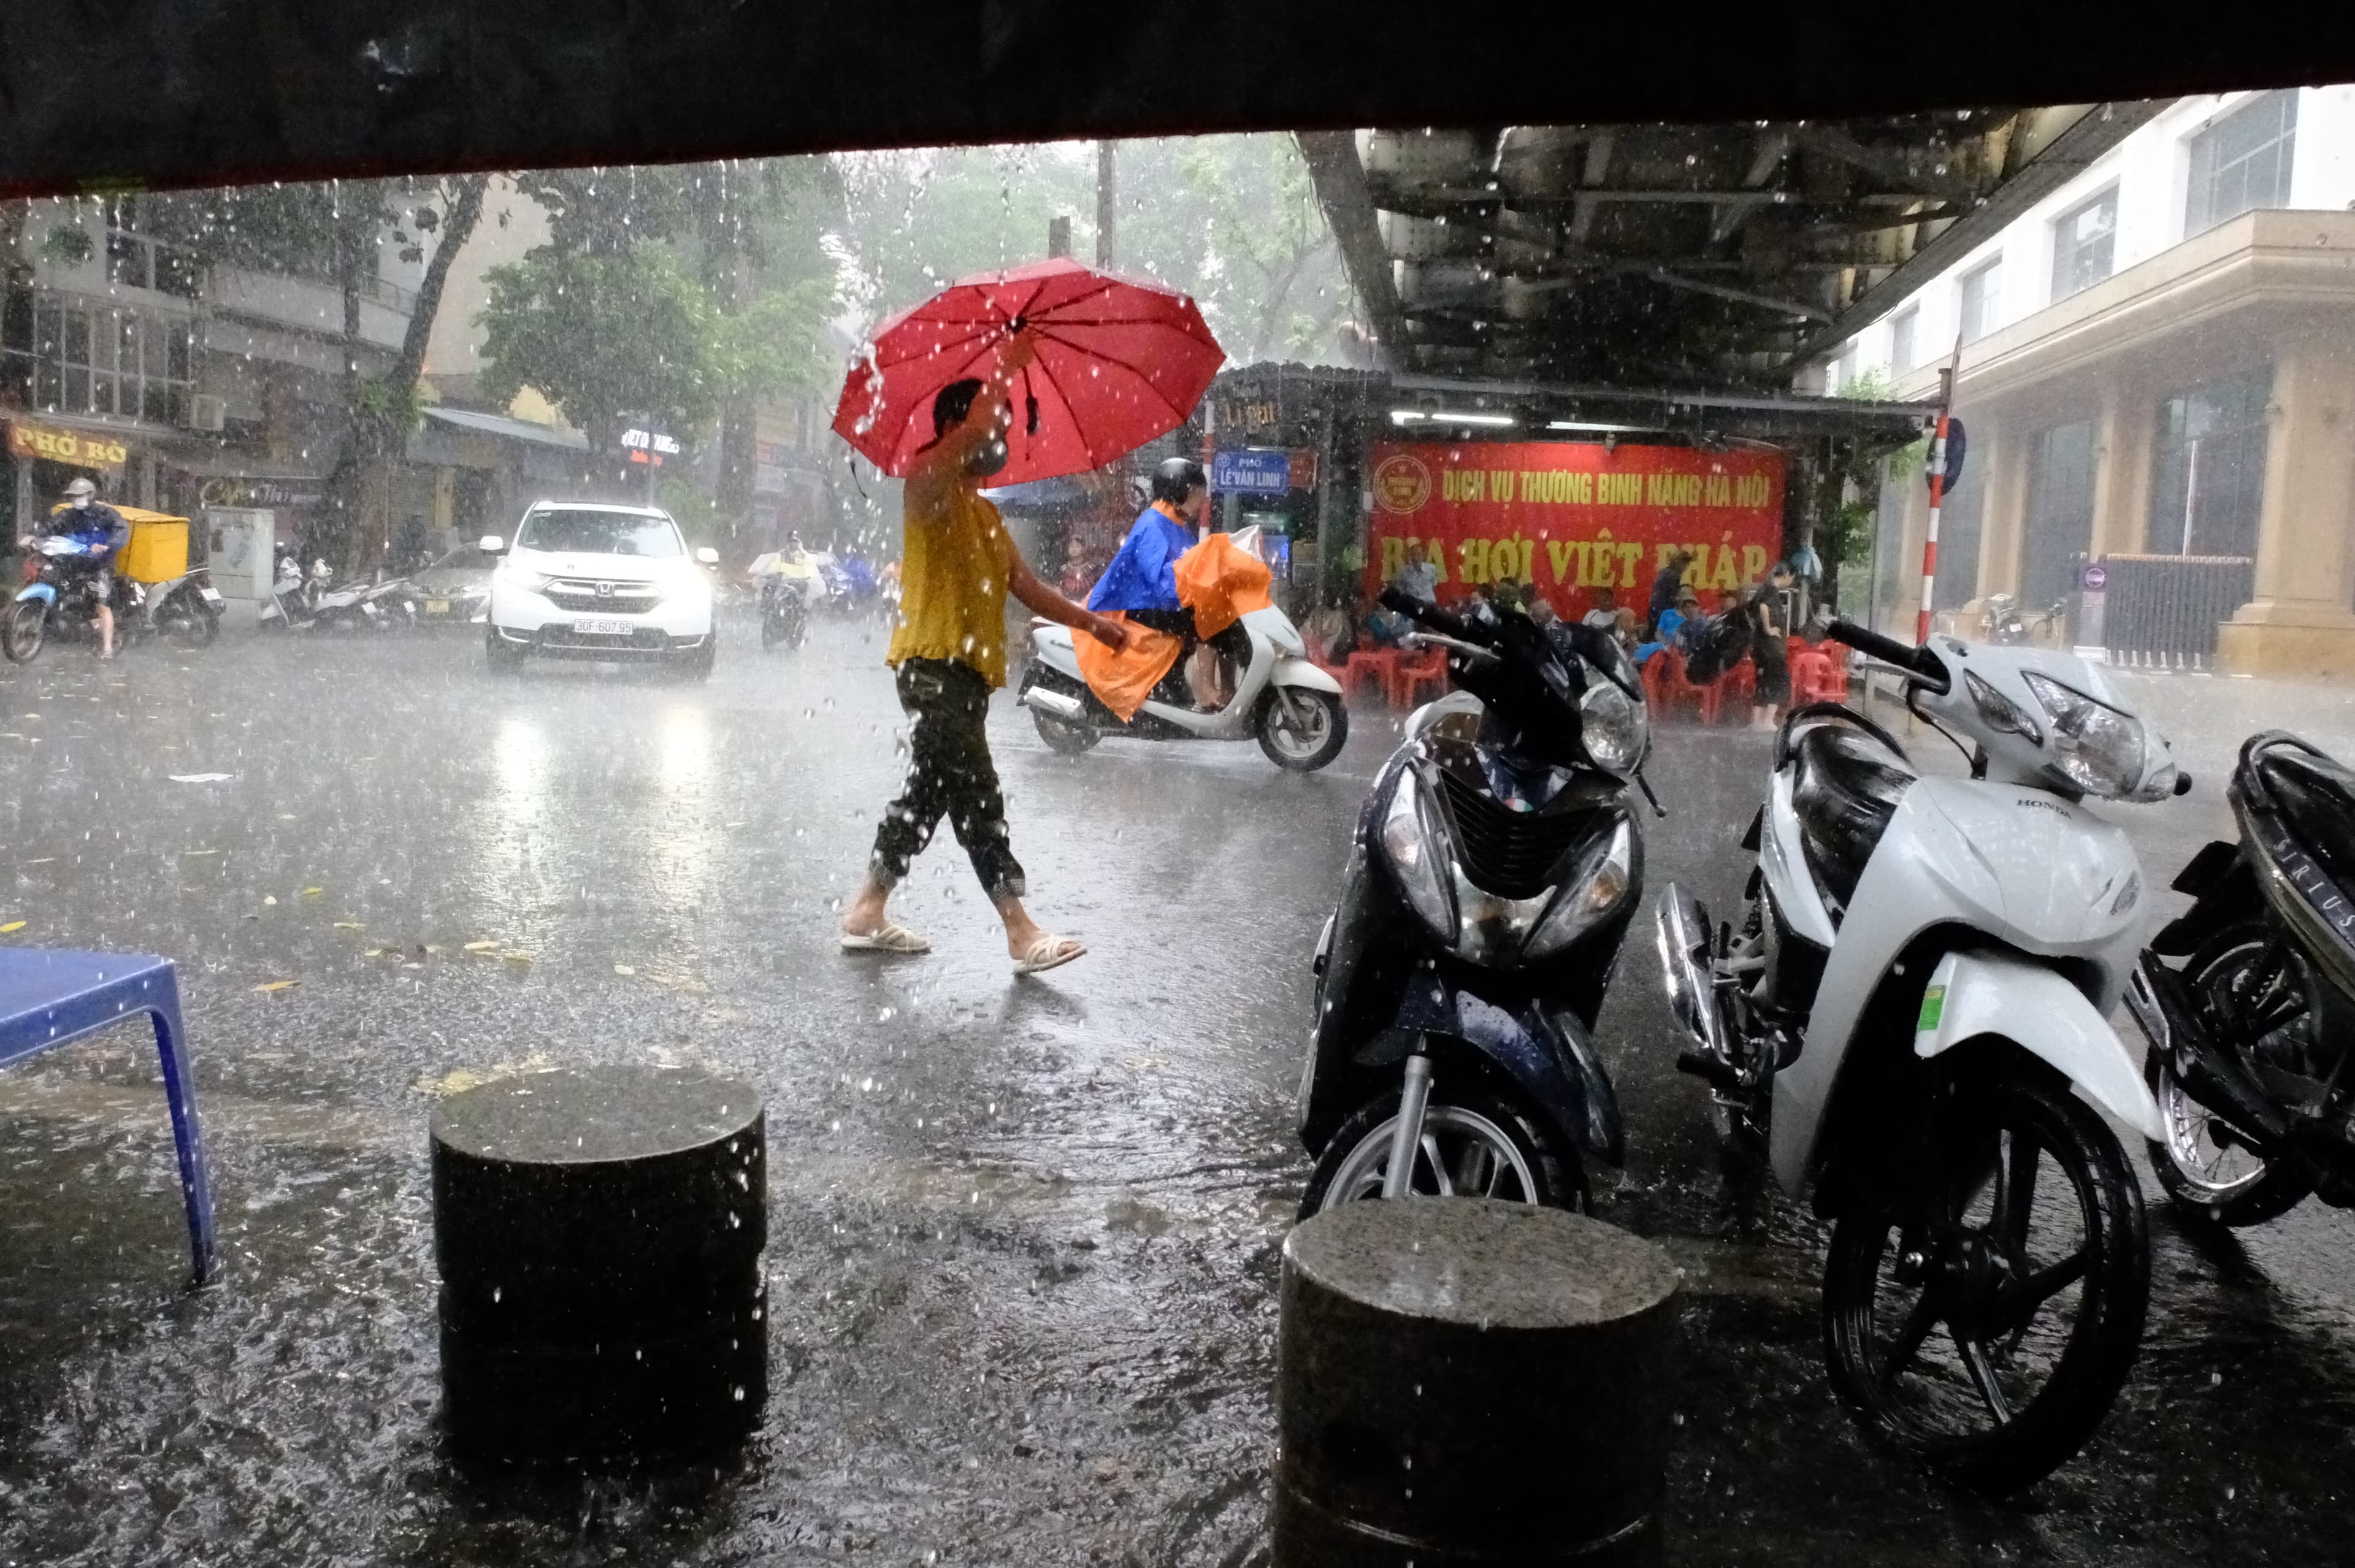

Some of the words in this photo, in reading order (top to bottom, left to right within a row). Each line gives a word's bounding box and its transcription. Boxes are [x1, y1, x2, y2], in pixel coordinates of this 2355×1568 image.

[1257, 472, 1281, 488] LINH
[1442, 470, 1485, 508] DỊCH
[1490, 470, 1514, 510] VỤ
[1520, 468, 1593, 505] THƯƠNG
[1598, 473, 1643, 506] BINH
[2016, 799, 2072, 820] HONDA
[2273, 838, 2355, 927] SIRIUS
